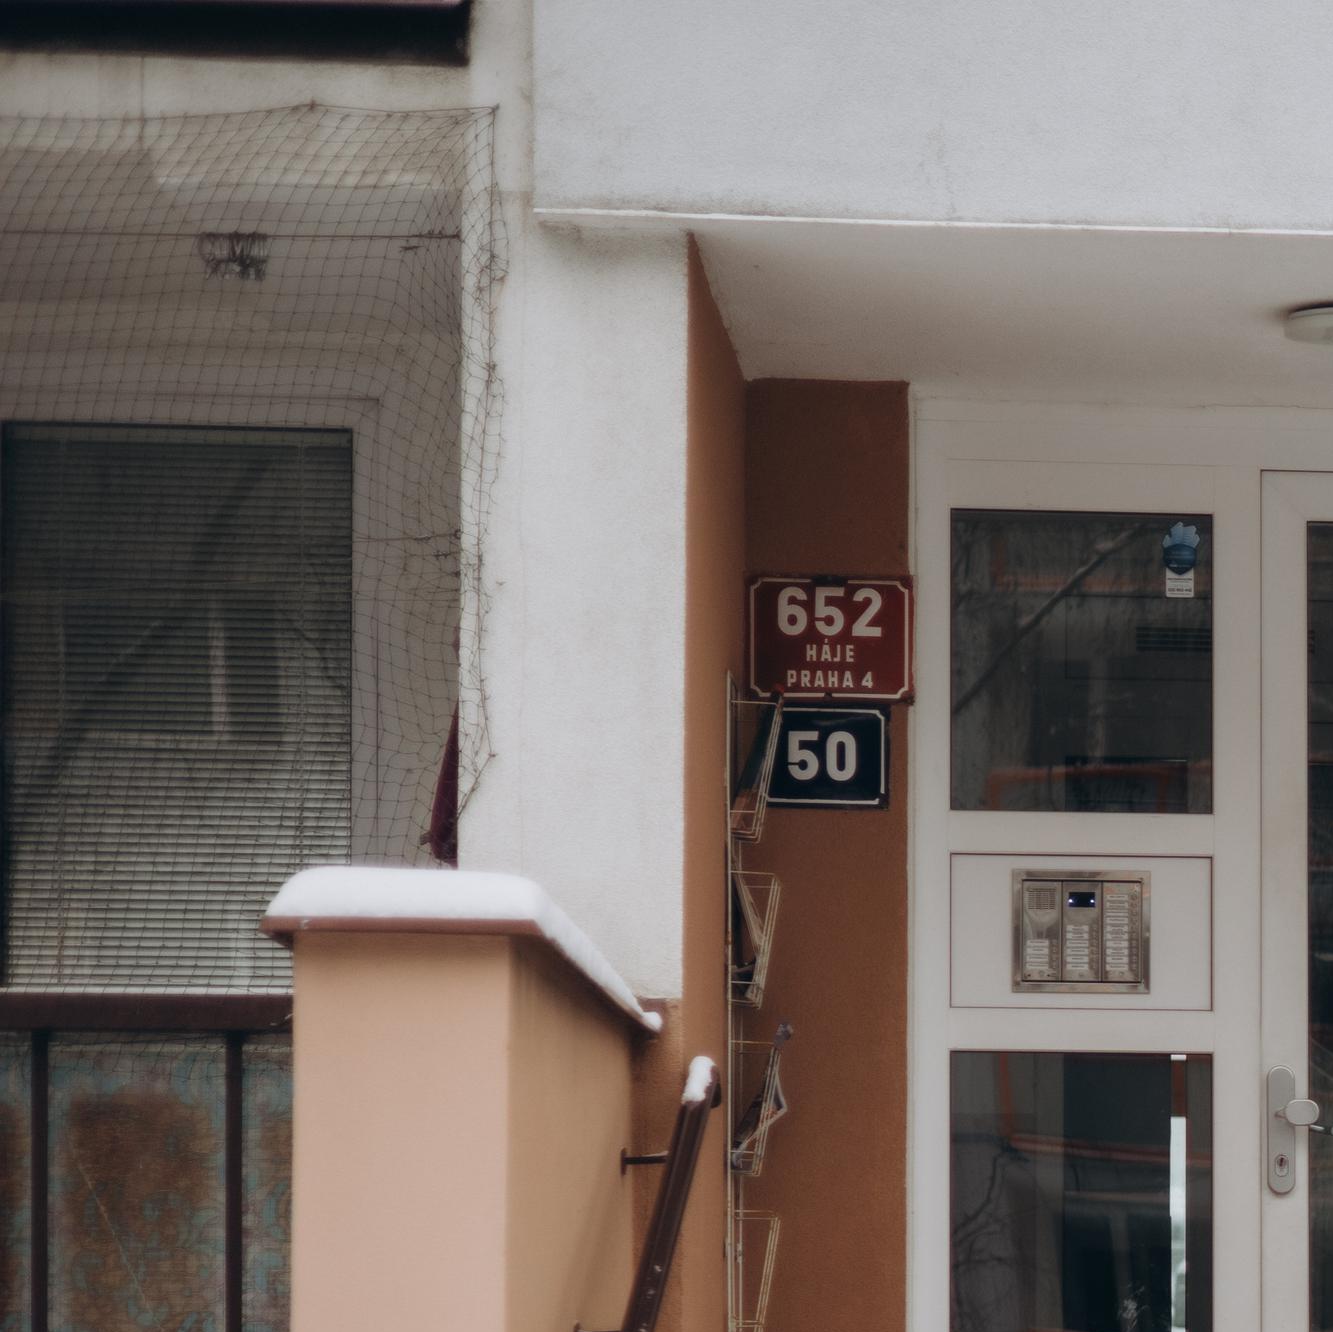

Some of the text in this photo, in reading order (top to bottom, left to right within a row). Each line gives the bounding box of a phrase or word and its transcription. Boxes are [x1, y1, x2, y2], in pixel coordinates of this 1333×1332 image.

[777, 586, 882, 637] 652
[806, 638, 855, 662] HÁJE
[787, 670, 873, 688] PRAHA 4
[787, 730, 857, 782] 50
